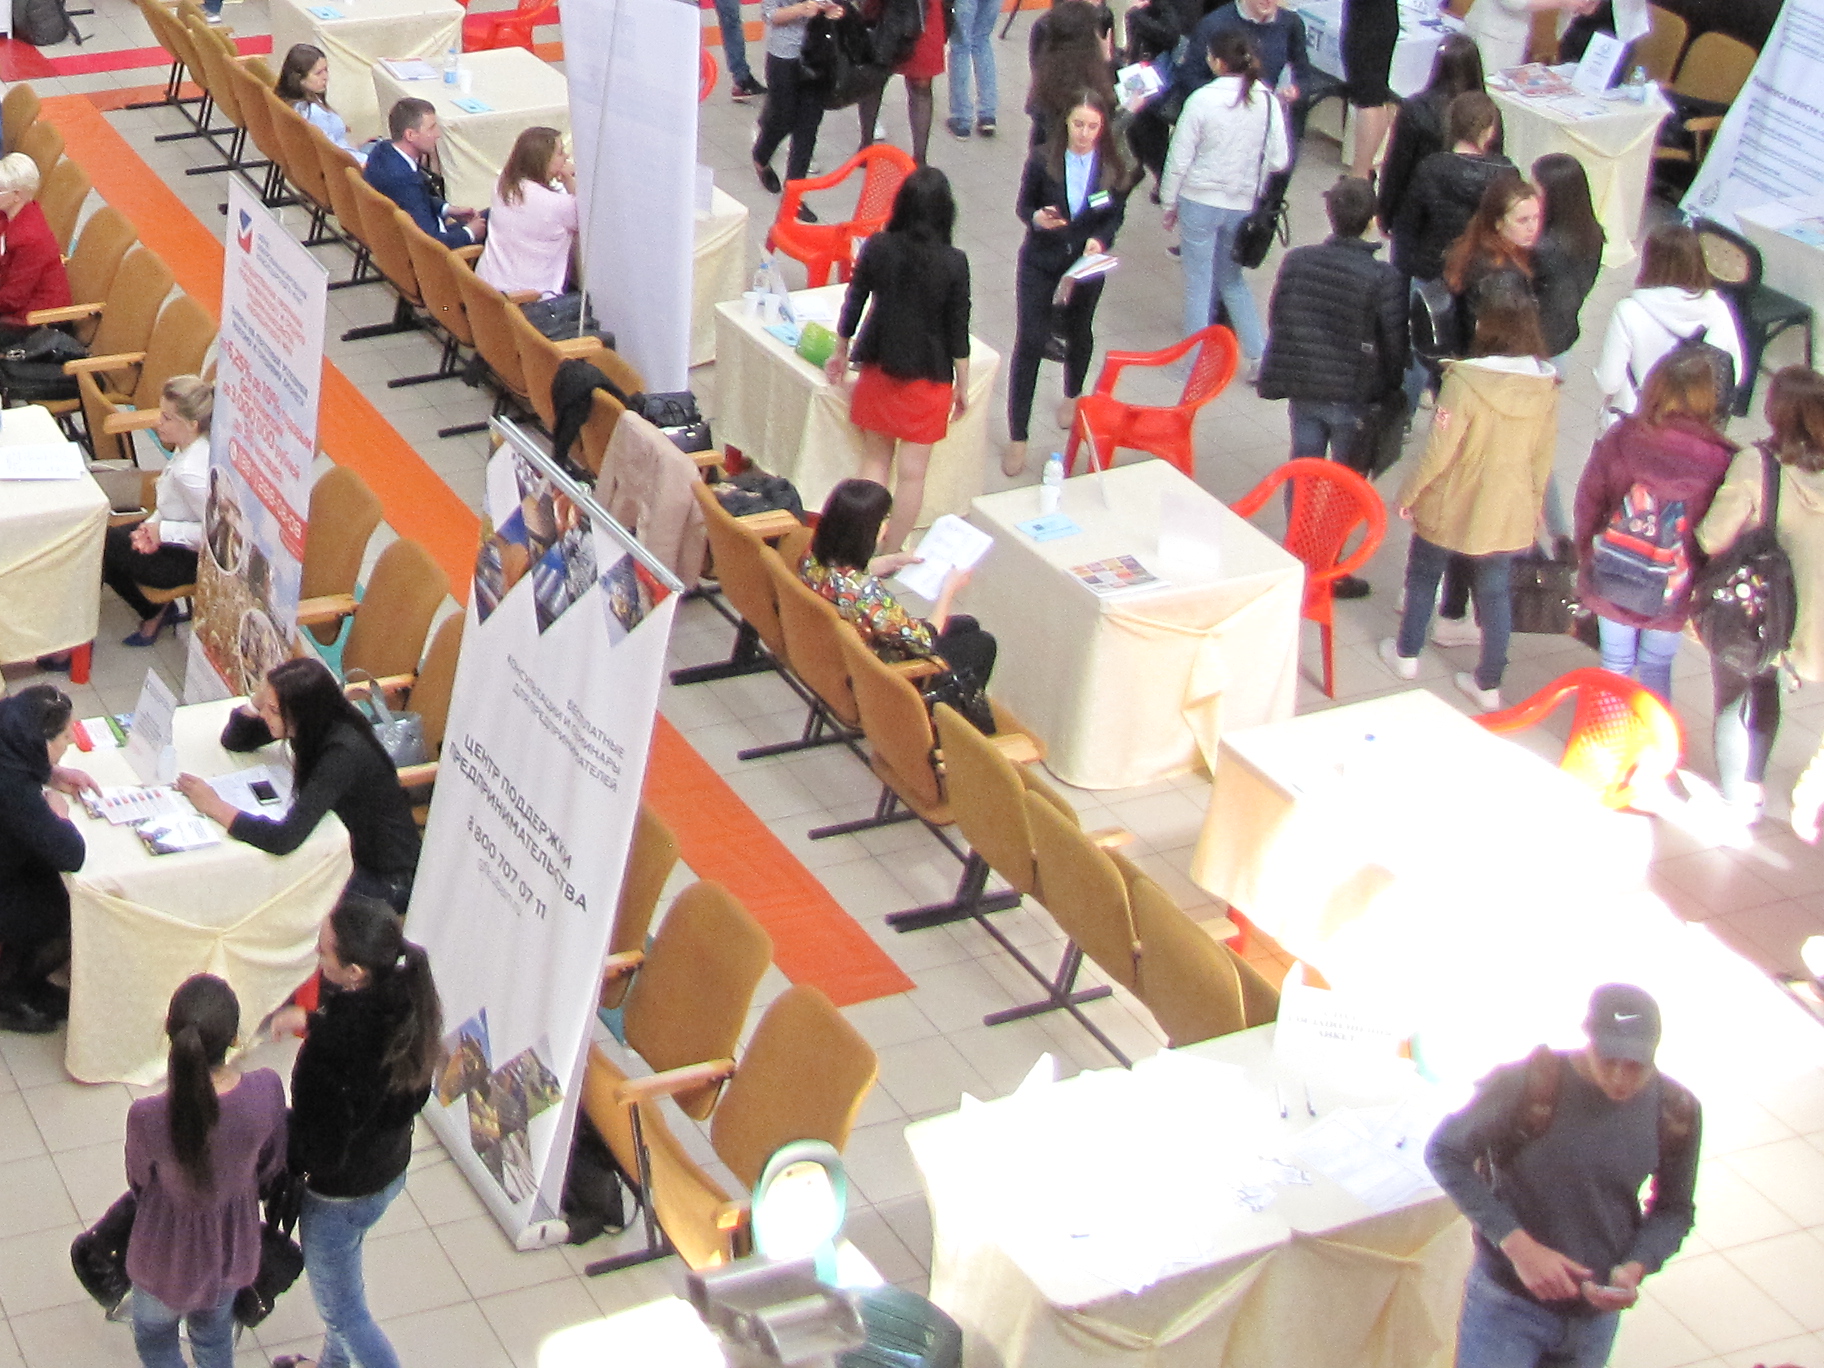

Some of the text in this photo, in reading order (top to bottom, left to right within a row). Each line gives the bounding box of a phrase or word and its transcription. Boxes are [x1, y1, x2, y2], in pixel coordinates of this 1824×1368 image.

[449, 741, 588, 913] ПРЕДПРИНИМАТЕЛЬСТВА
[464, 733, 573, 870] ЦЕНТР ПОДДЕРЖКИ
[474, 825, 496, 859] 800
[497, 852, 518, 883] 707
[518, 880, 534, 904] 07
[534, 898, 547, 920] 11
